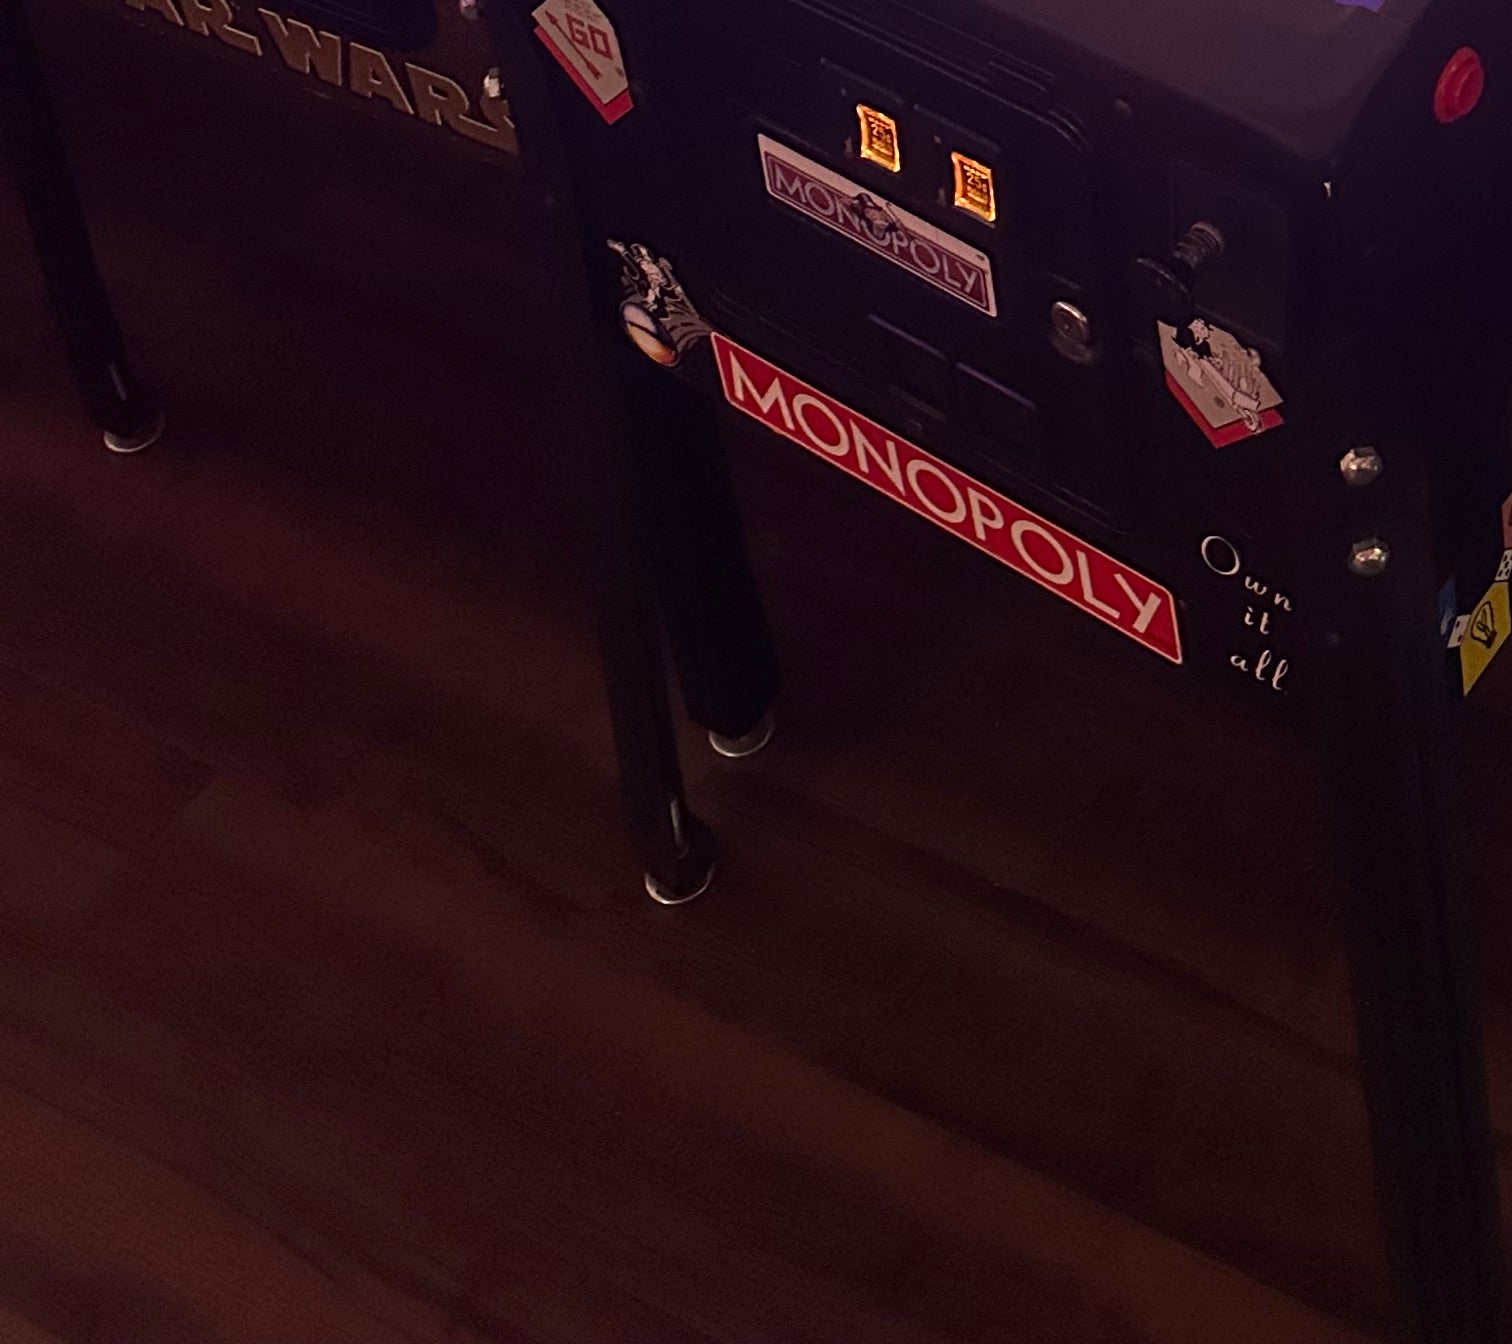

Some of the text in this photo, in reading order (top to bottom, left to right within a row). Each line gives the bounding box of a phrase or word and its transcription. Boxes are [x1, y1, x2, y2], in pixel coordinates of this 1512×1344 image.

[258, 7, 519, 156] WARS
[565, 13, 614, 61] GO
[775, 168, 978, 293] MONOPOLY
[728, 349, 1162, 634] MONOPOLY
[1201, 534, 1294, 612] Own
[1243, 605, 1270, 636] it
